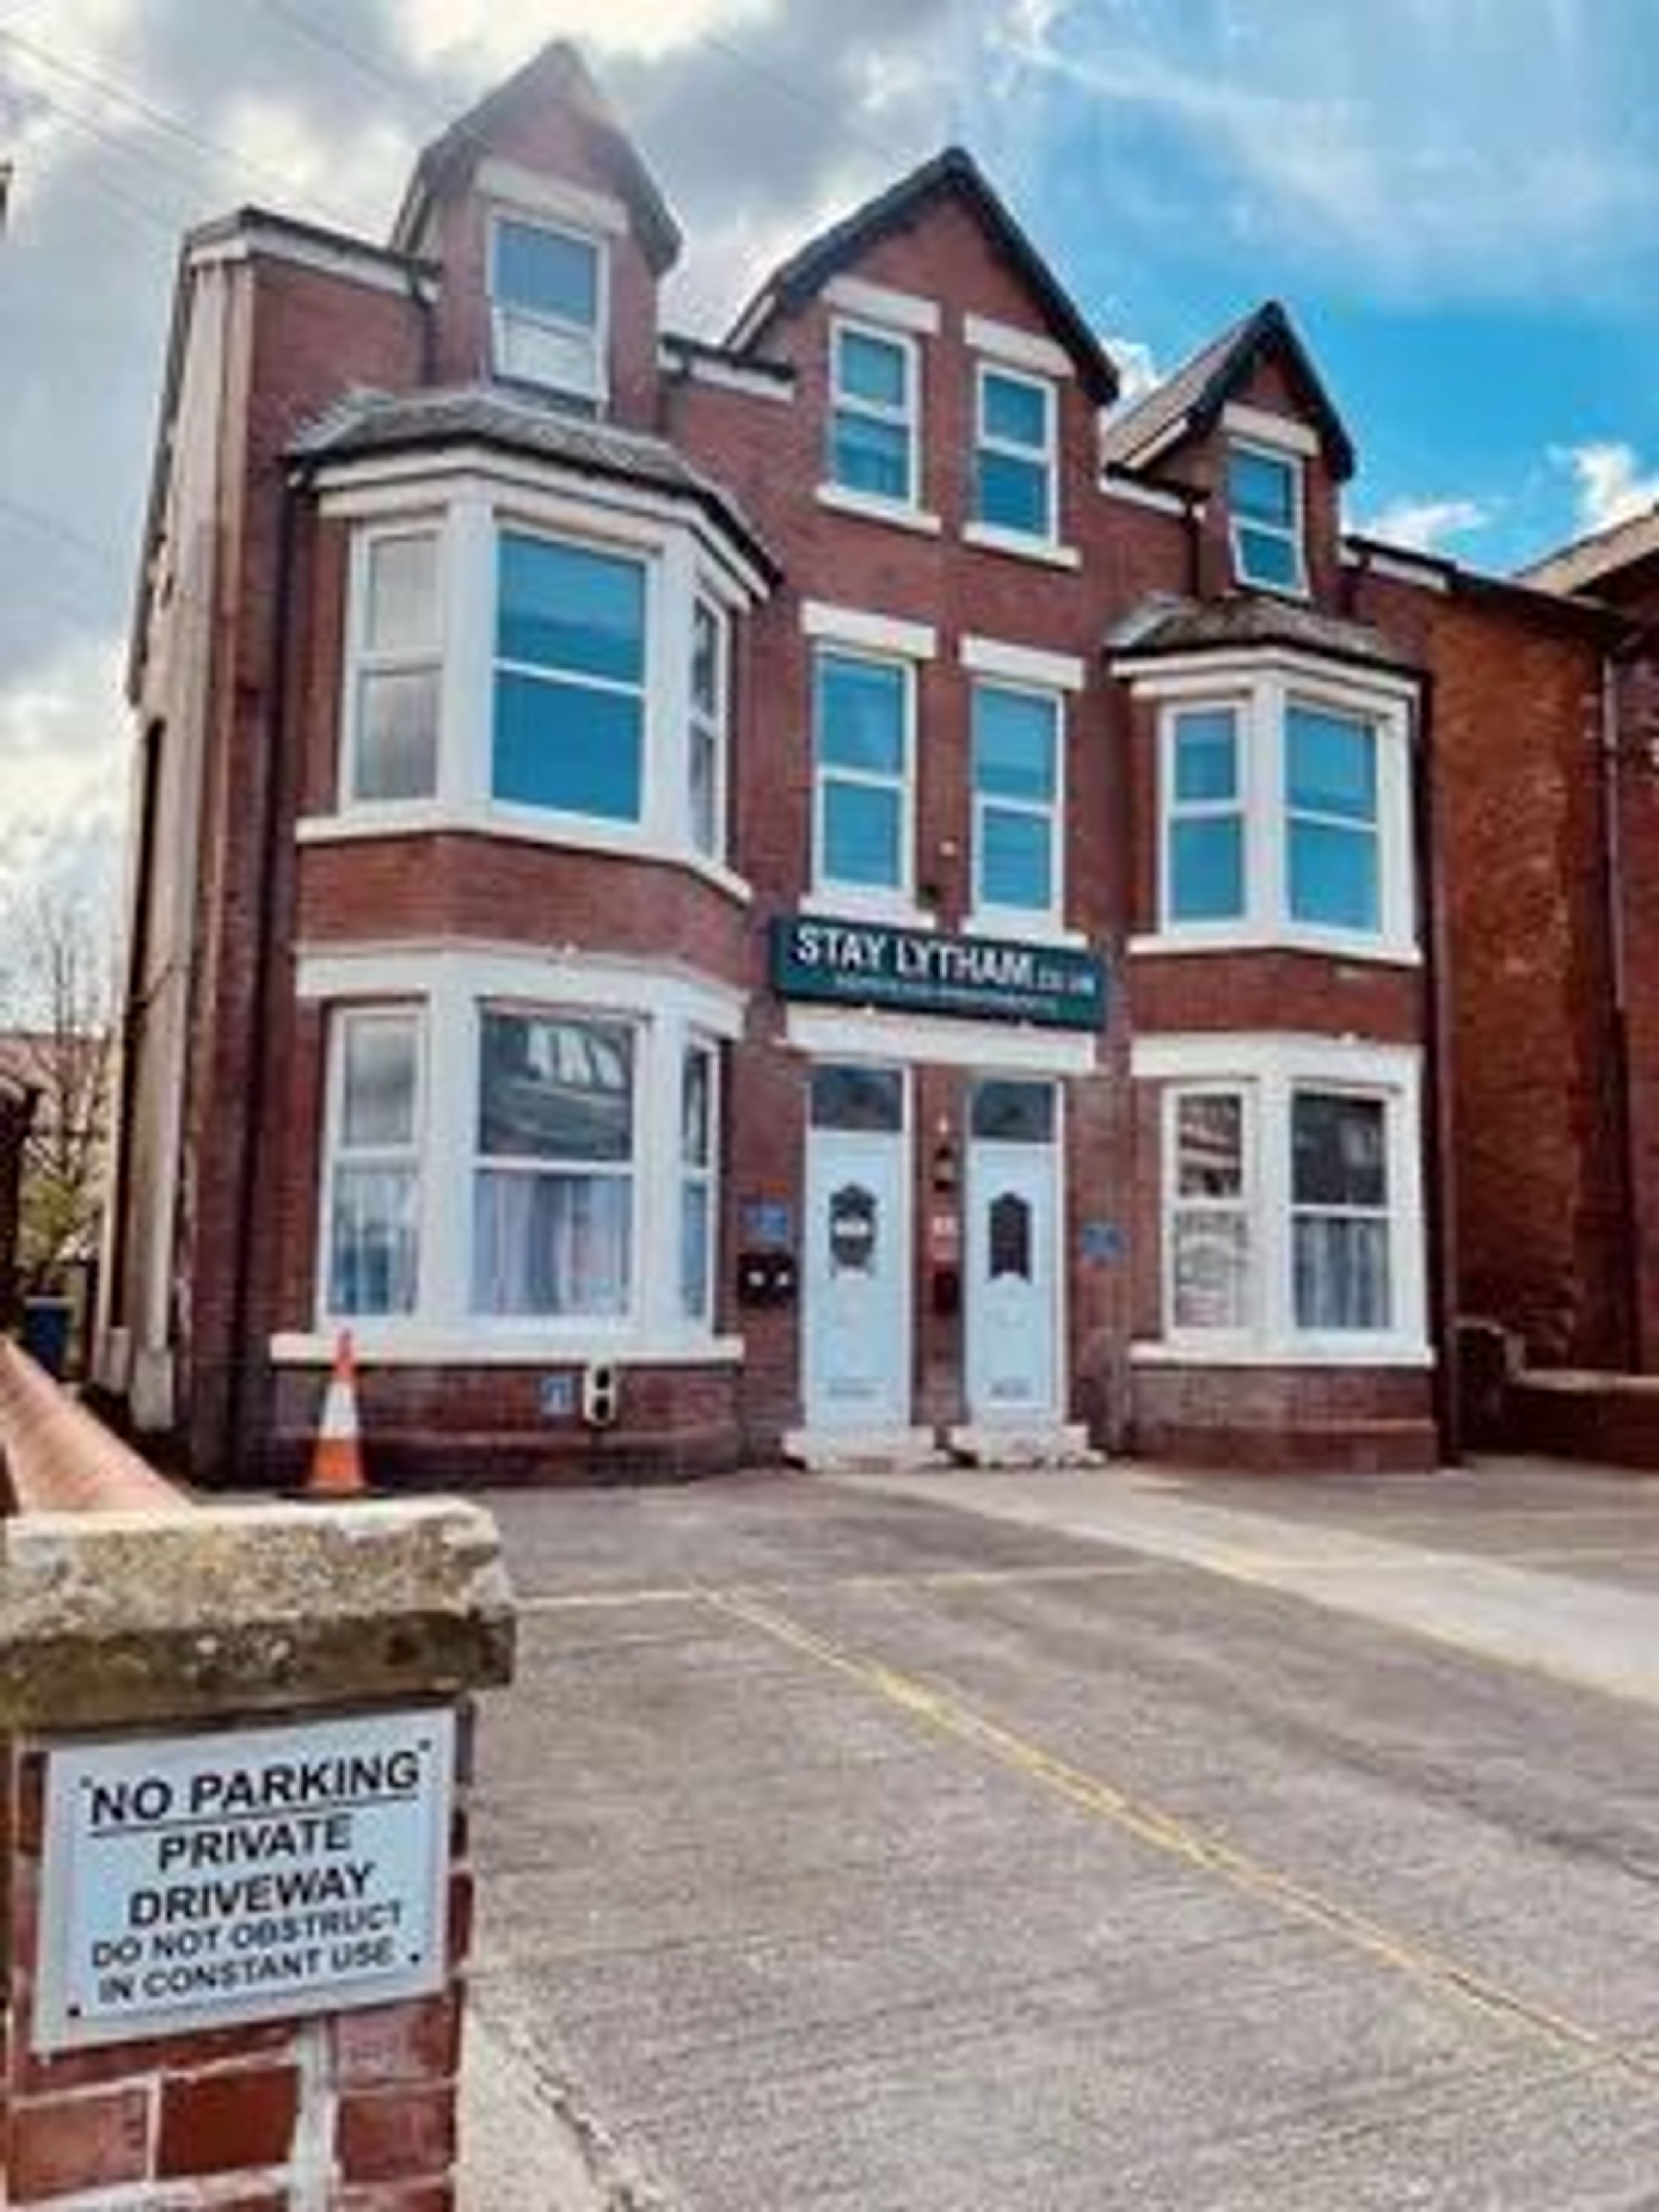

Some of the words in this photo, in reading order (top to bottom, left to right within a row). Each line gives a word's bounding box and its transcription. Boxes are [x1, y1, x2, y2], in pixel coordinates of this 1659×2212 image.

[797, 925, 886, 970] STAY
[91, 1780, 172, 1824] NO
[190, 1751, 420, 1813] PARKING
[159, 1815, 353, 1870] PRIVATE
[131, 1863, 372, 1926] DRIVEWAY
[92, 1937, 143, 1968] DO
[152, 1926, 220, 1958] NOT
[230, 1902, 402, 1949] OBSTRUCT
[99, 1975, 134, 2003] IN
[142, 1952, 321, 1997] CONSTANT
[330, 1938, 391, 1971] USE
